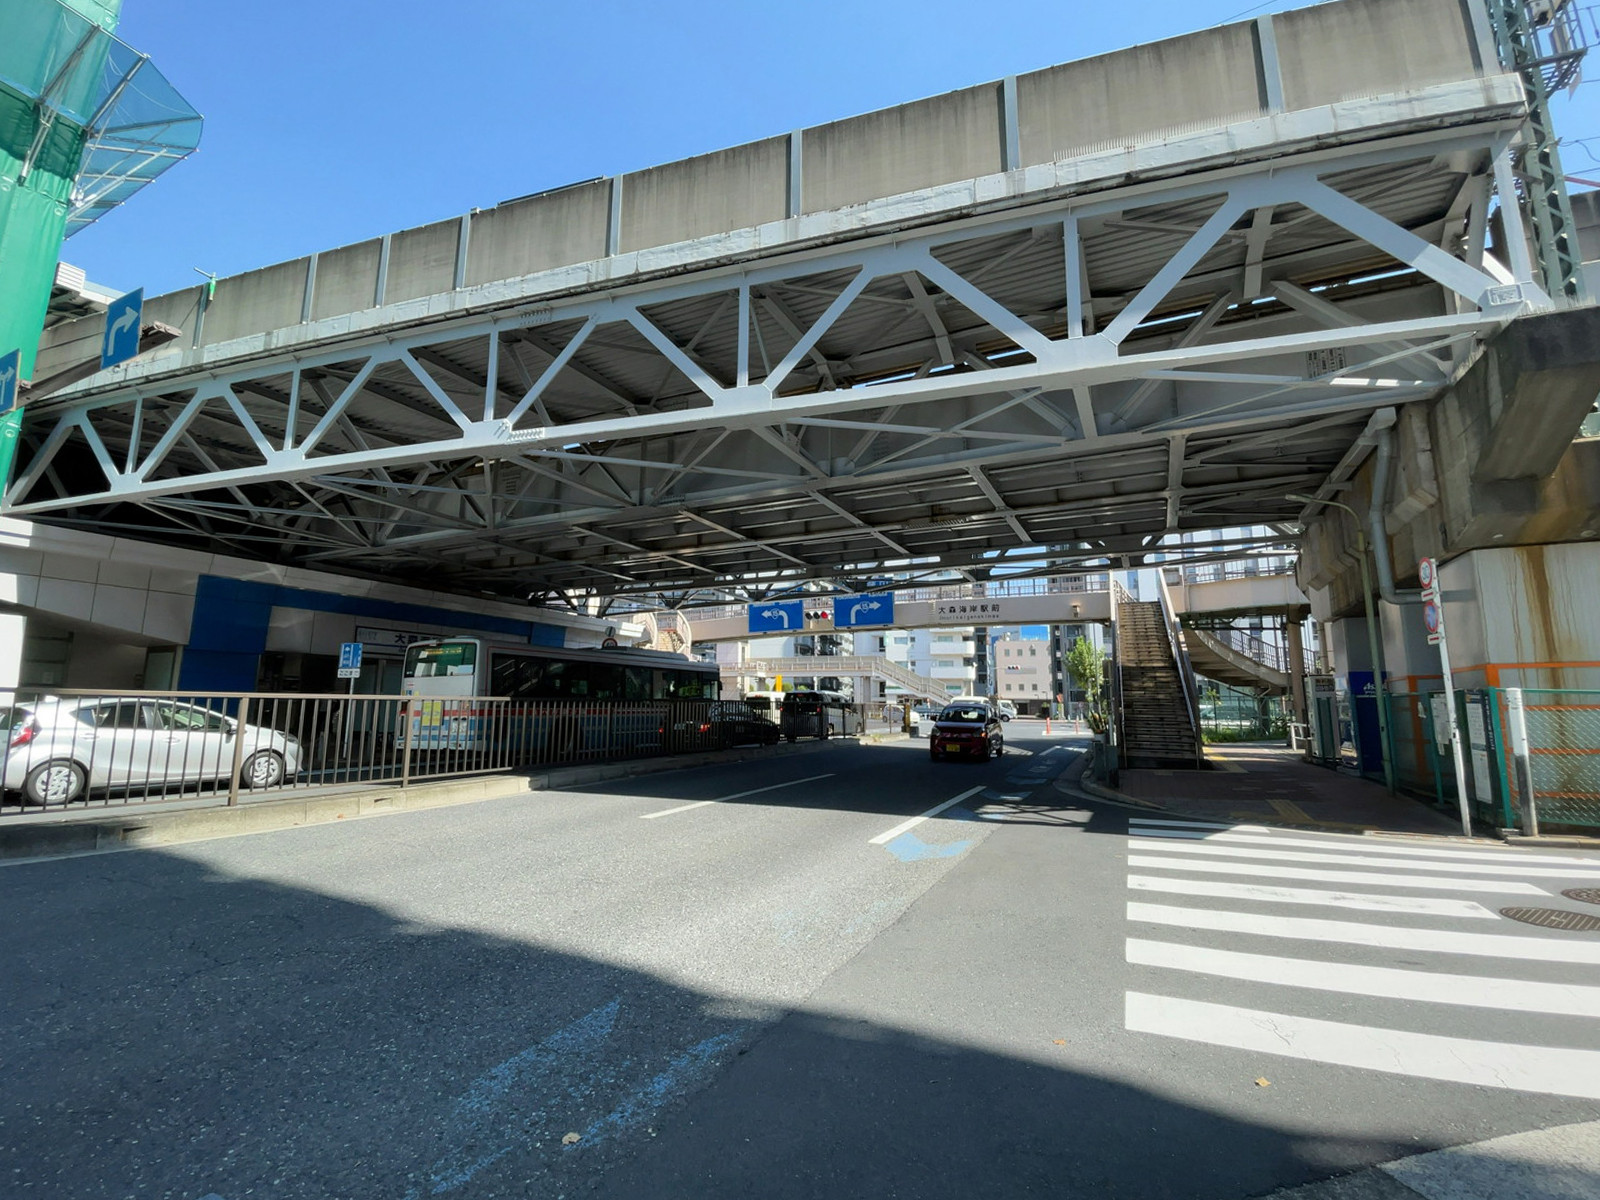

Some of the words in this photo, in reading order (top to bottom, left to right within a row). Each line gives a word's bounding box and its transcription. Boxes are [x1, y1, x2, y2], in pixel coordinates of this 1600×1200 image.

[938, 604, 1000, 615] 大森海岸駅前
